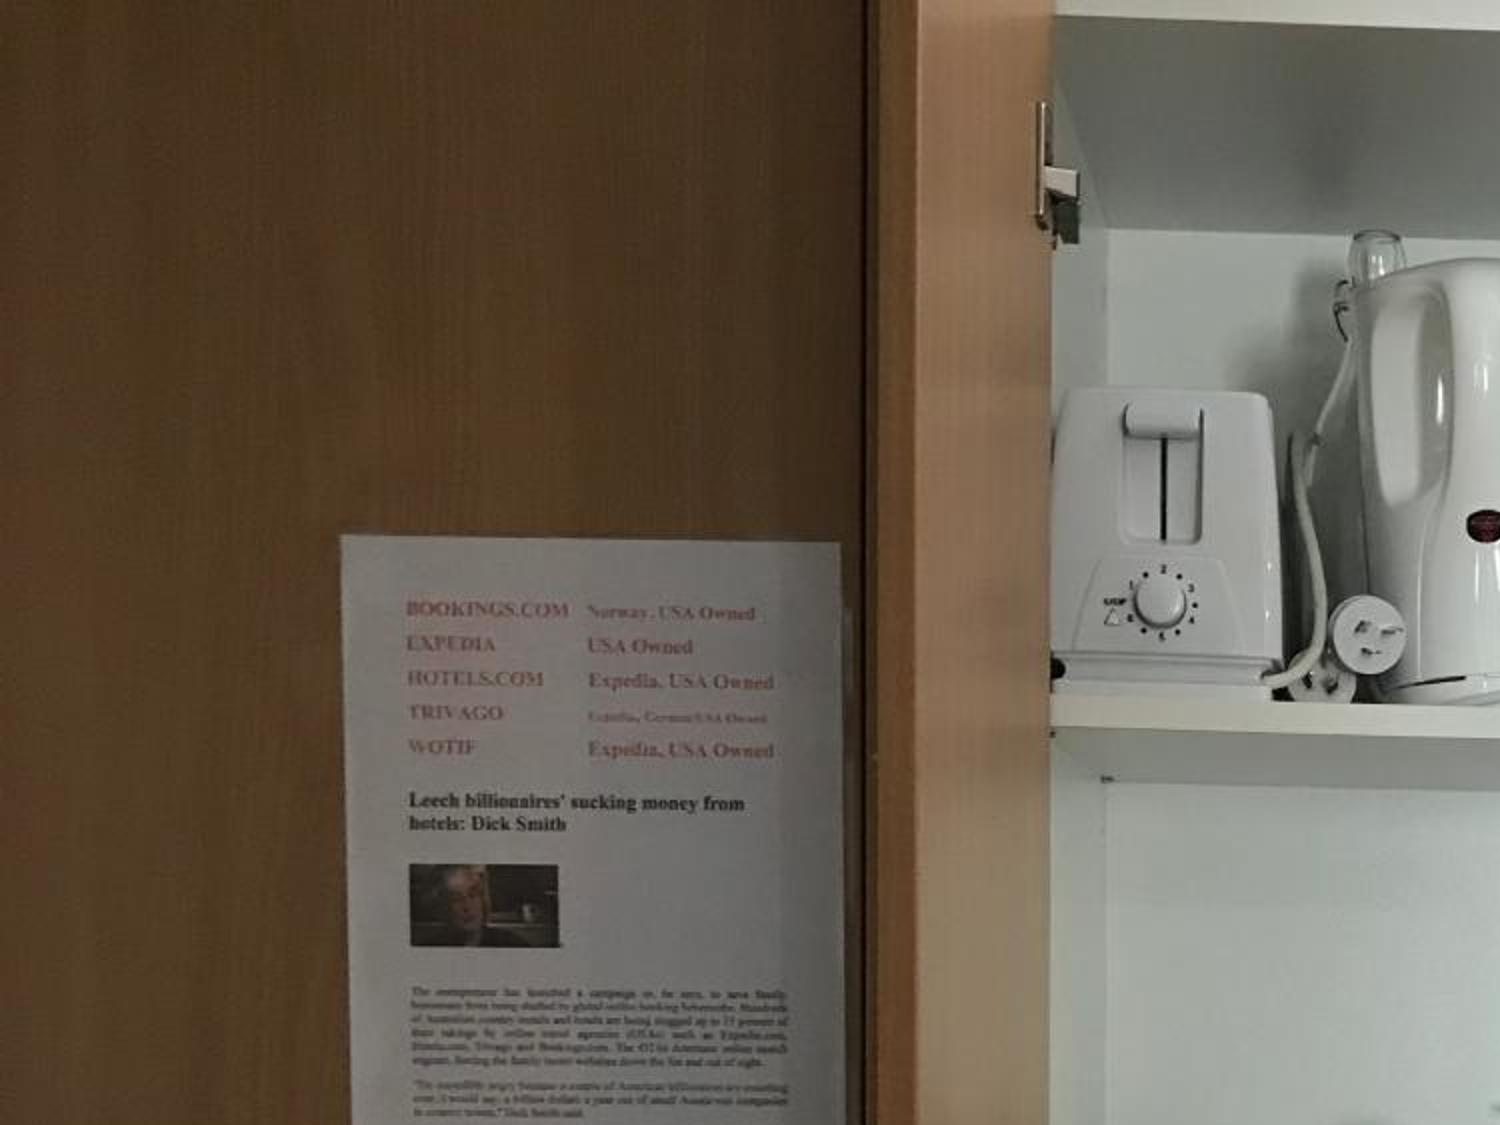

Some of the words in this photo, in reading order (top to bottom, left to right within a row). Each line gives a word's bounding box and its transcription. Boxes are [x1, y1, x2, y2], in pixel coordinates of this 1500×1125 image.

[406, 602, 569, 619] BOOKINGS.COM
[658, 605, 695, 620] USA
[699, 605, 757, 620] Owned
[406, 635, 496, 652] EXPEDIA
[587, 638, 626, 654] USA
[631, 638, 694, 655] Owned
[406, 671, 545, 687] HOTELS.COM
[668, 674, 708, 690] USA
[713, 674, 775, 691] Owned
[408, 704, 504, 721] TRIVAGO
[408, 738, 479, 756] WOTIF
[668, 741, 708, 758] USA
[713, 741, 775, 759] Owned
[408, 791, 460, 809] Leech
[570, 793, 637, 815] sucking
[641, 797, 698, 815] money
[703, 794, 746, 812] from
[408, 814, 466, 832] hotels:
[470, 814, 510, 832] Dick
[515, 814, 567, 832] Smith
